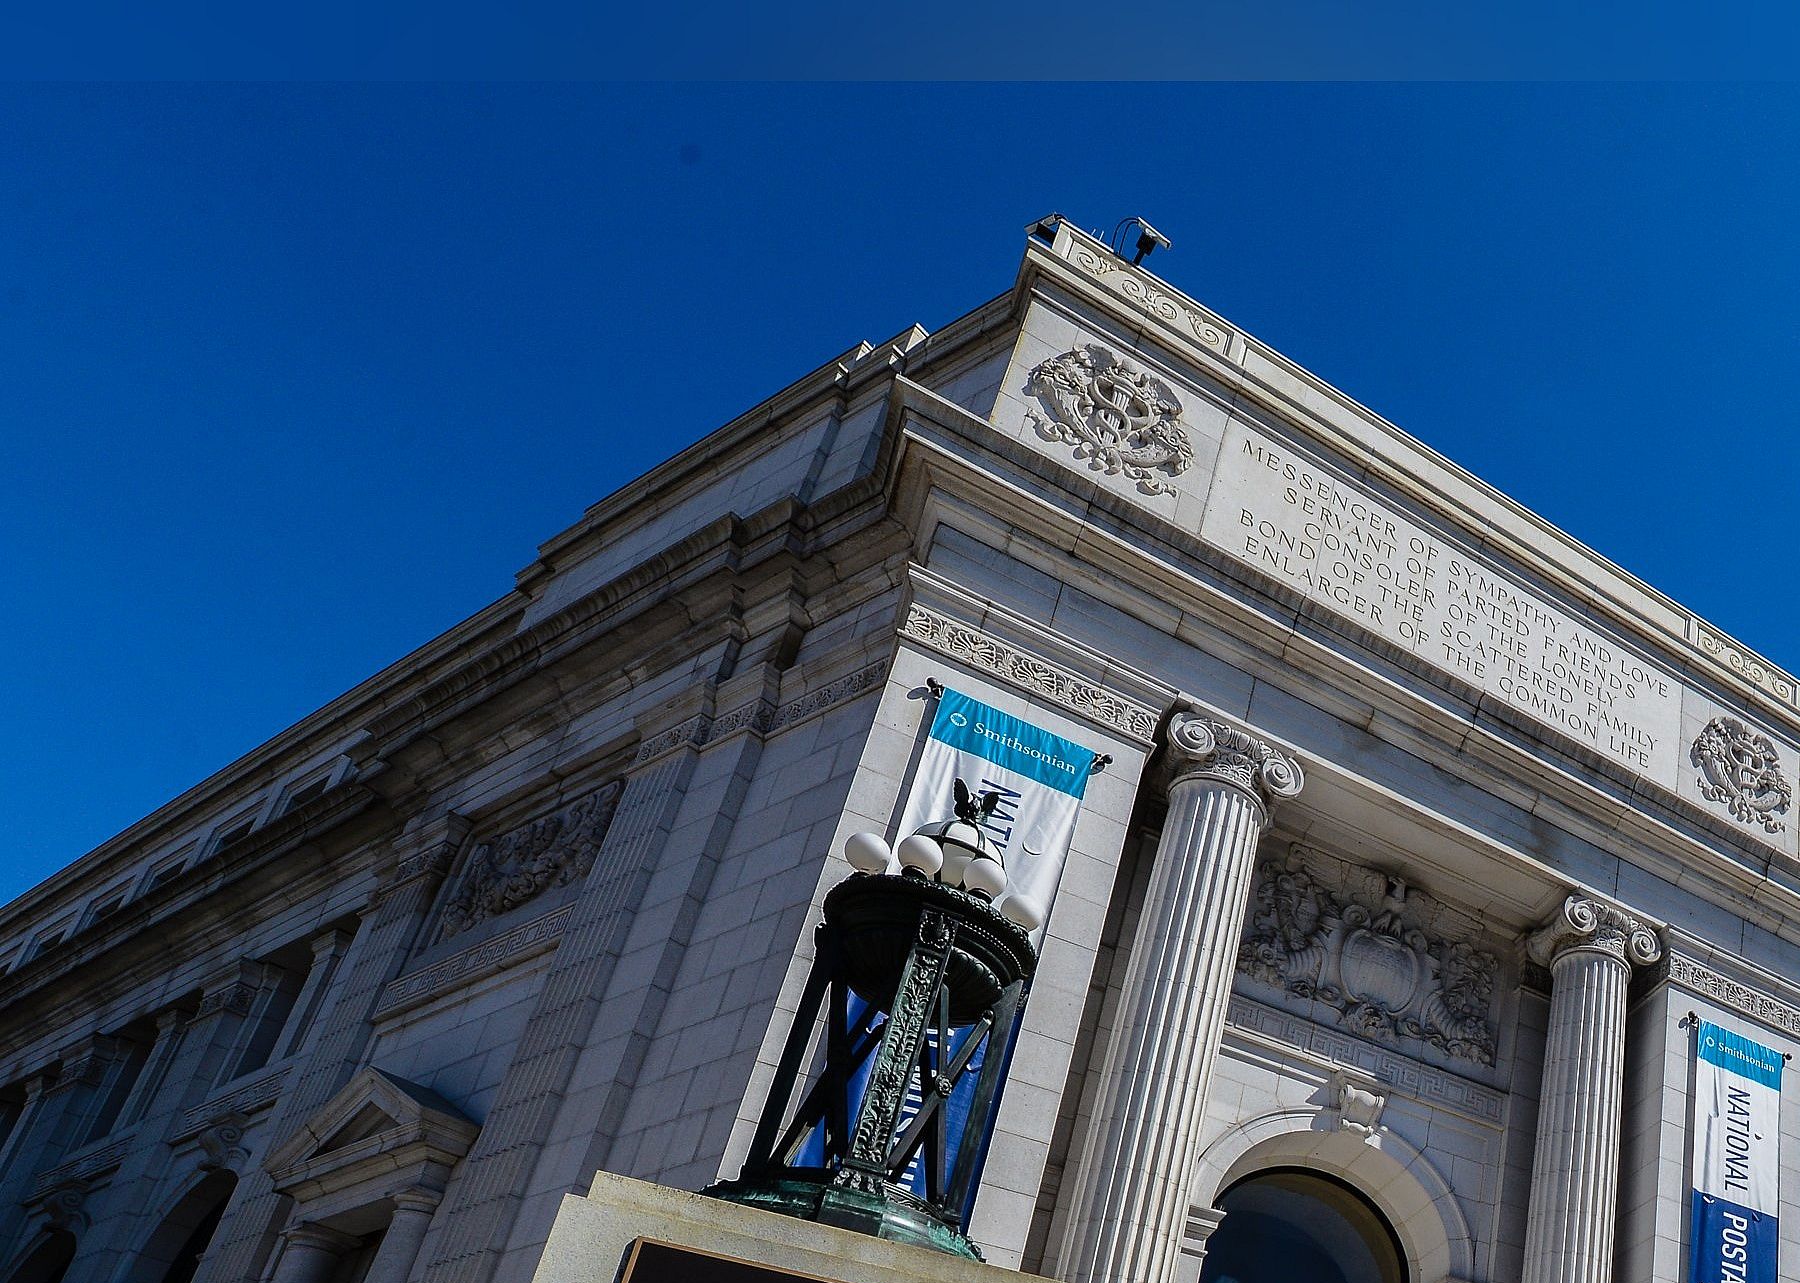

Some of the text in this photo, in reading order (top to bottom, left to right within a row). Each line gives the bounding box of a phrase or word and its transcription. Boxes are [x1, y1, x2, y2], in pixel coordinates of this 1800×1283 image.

[1241, 438, 1669, 699] MESSENGER OF SYMPATHY AND LOVE
[1241, 509, 1659, 752] BOND OF THE SCATTERED FAMILY
[1245, 537, 1650, 769] ENLARGER OF THE COMMON LIFE
[1283, 487, 1637, 699] SERVANT OF PARTED FRIENDS
[1305, 522, 1619, 710] CONSOLER OF THE LONELY
[973, 721, 1077, 775] Smithsonian
[1718, 1042, 1775, 1073] Smithsonian
[1722, 1085, 1751, 1193] NATIONAL
